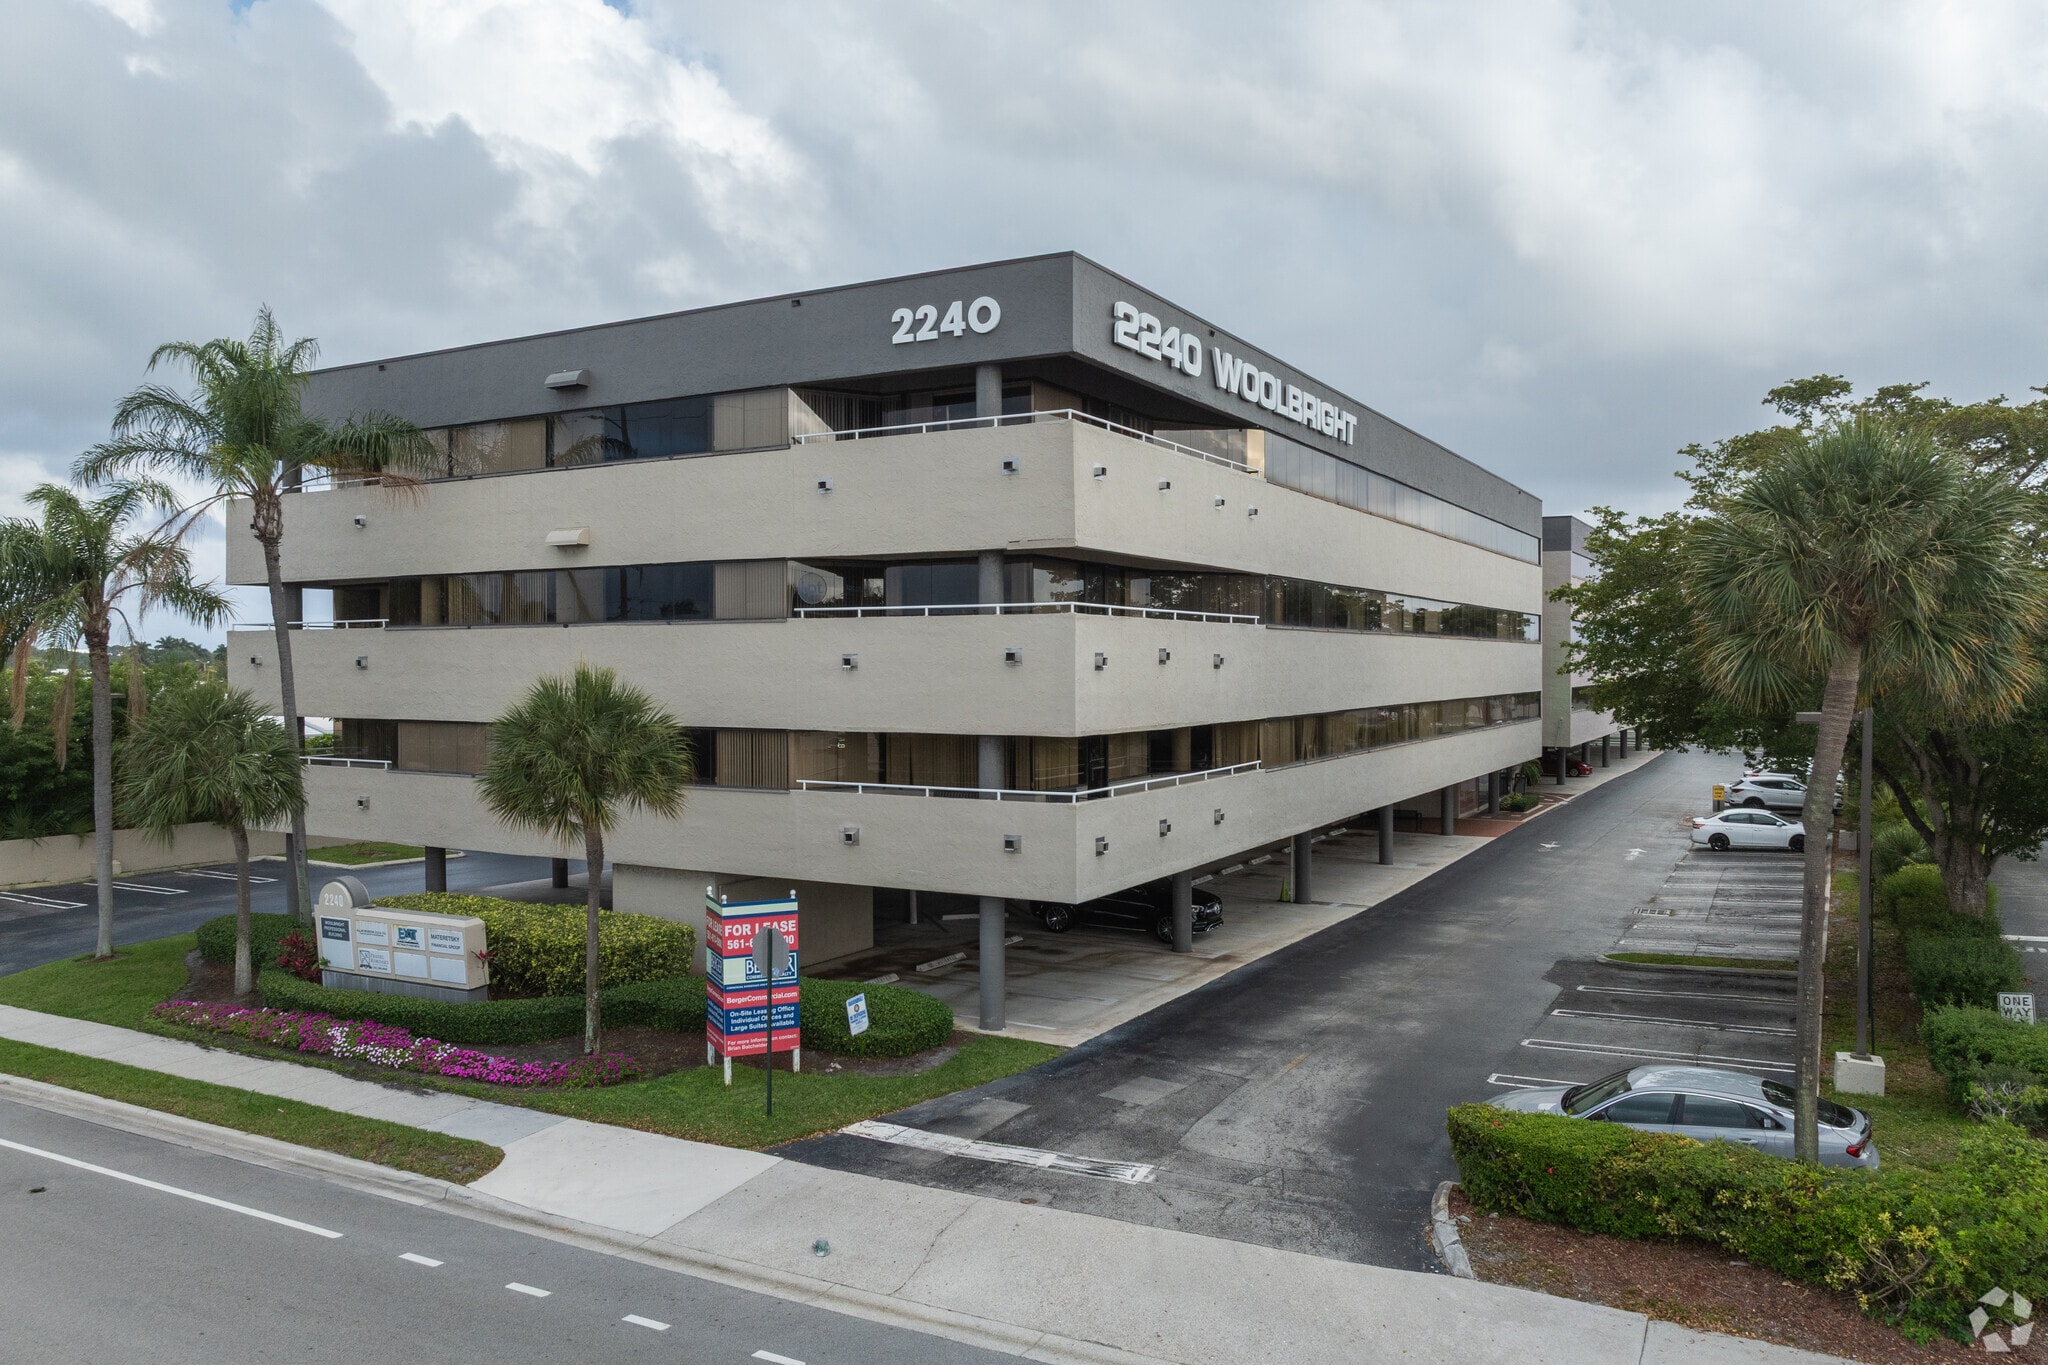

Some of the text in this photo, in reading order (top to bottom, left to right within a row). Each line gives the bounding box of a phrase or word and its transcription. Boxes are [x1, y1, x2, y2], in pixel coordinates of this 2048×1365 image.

[891, 295, 1002, 345] 2240
[1113, 300, 1358, 446] 2240 WOOLBRIGHT
[324, 892, 344, 907] 2240
[398, 927, 417, 940] EXIT
[724, 924, 751, 936] FOR
[726, 992, 797, 1004] BergerCommcial.com
[2003, 996, 2030, 1006] ONE
[730, 1009, 752, 1017] On-Site
[753, 1007, 777, 1015] Leasg
[2003, 1007, 2031, 1017] WAY
[730, 1015, 760, 1024] Individual
[760, 1013, 782, 1021] Ofces
[730, 1019, 795, 1032] Large Suites vailable
